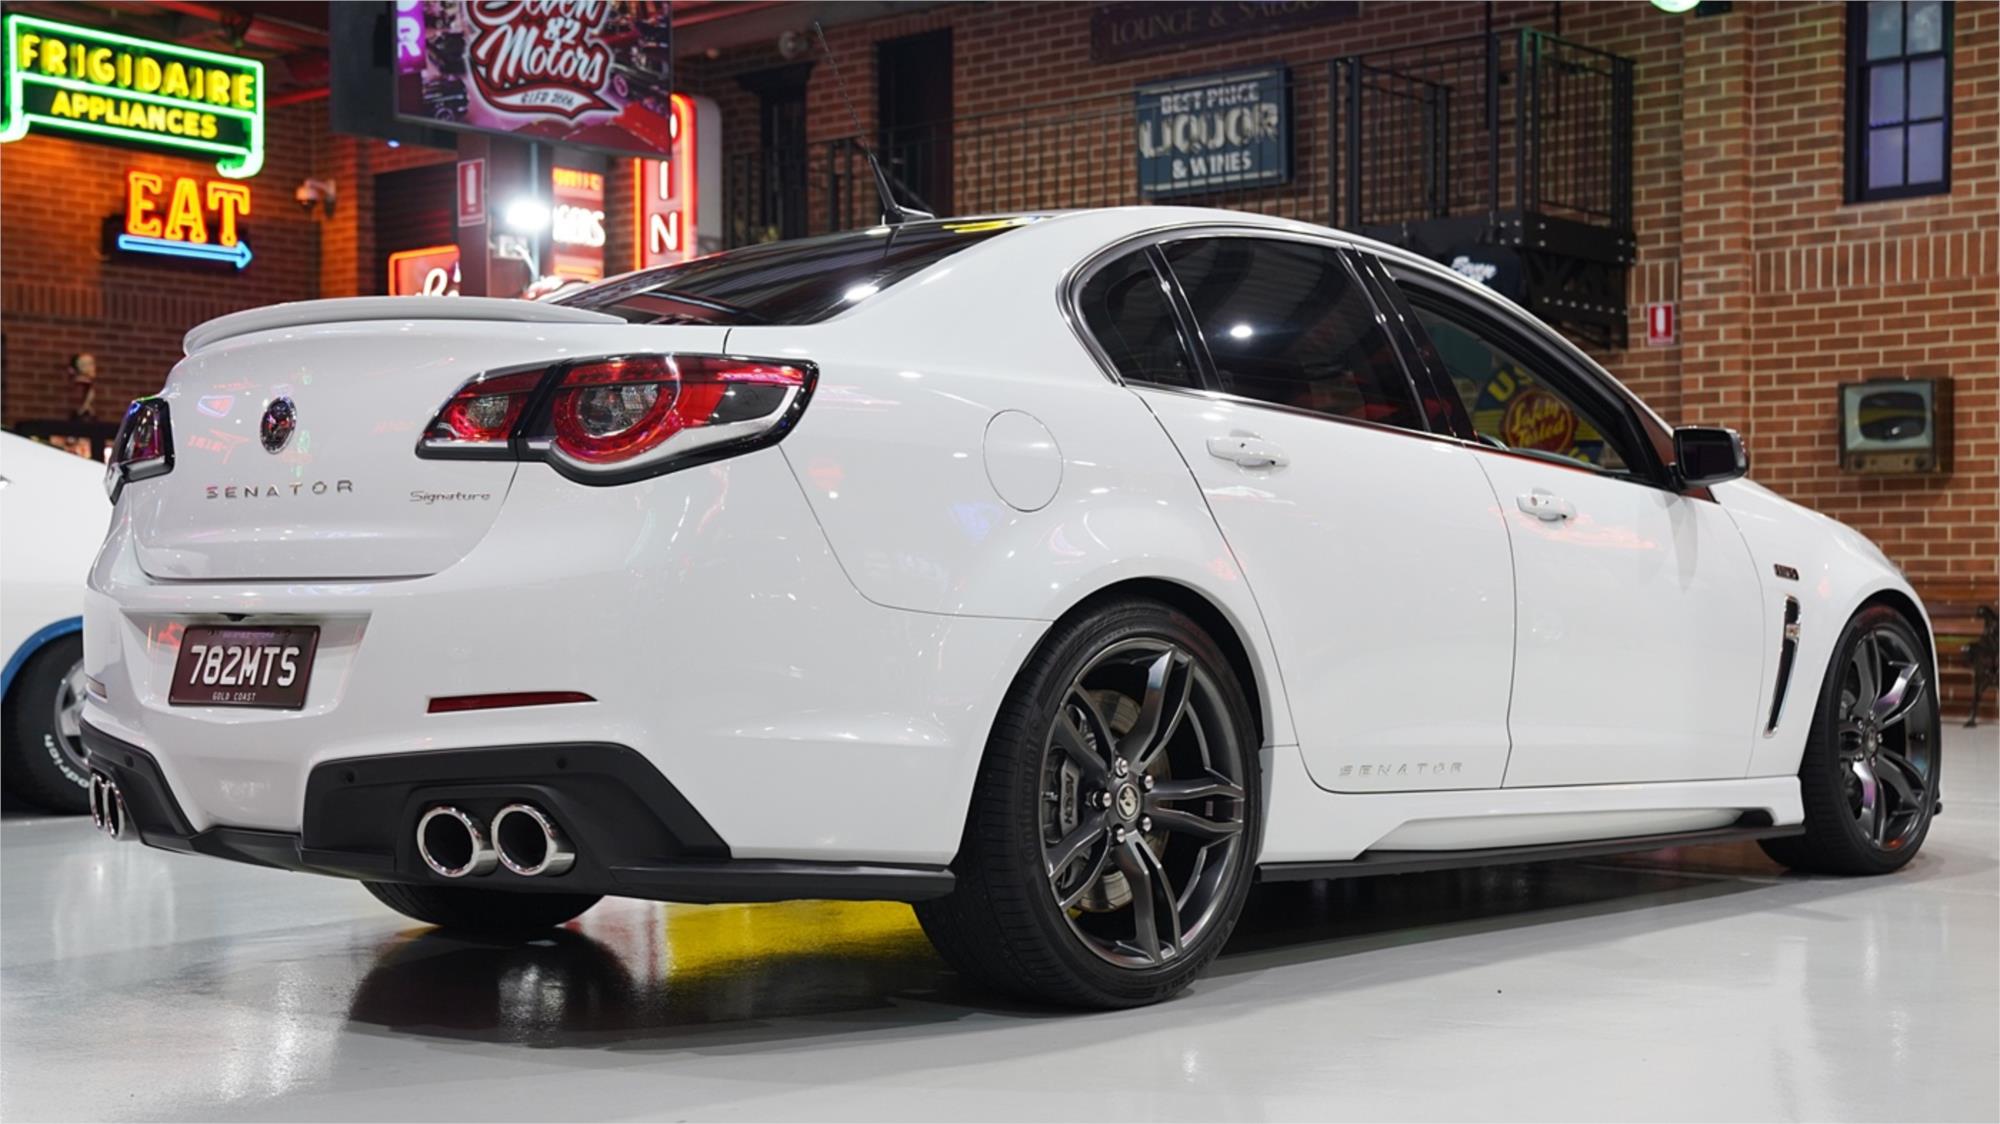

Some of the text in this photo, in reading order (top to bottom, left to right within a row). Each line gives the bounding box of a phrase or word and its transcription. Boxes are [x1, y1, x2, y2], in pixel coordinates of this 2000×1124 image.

[543, 17, 581, 45] 82
[1109, 7, 1199, 45] LOUNGE
[1208, 6, 1226, 28] &
[20, 34, 255, 108] FRIGIDAIRE
[477, 24, 604, 83] Motors
[51, 91, 218, 138] APPLIANCES
[1161, 82, 1260, 115] BEST PRICE
[1172, 150, 1252, 179] & WINES
[127, 171, 250, 247] EAT
[1511, 397, 1561, 434] Safety
[1517, 412, 1566, 447] Tested
[206, 479, 353, 499] SENATOR
[409, 490, 491, 505] Signature
[190, 645, 300, 687] 782MTS
[212, 691, 256, 702] GOLD COAST
[1339, 762, 1462, 776] SENATOR
